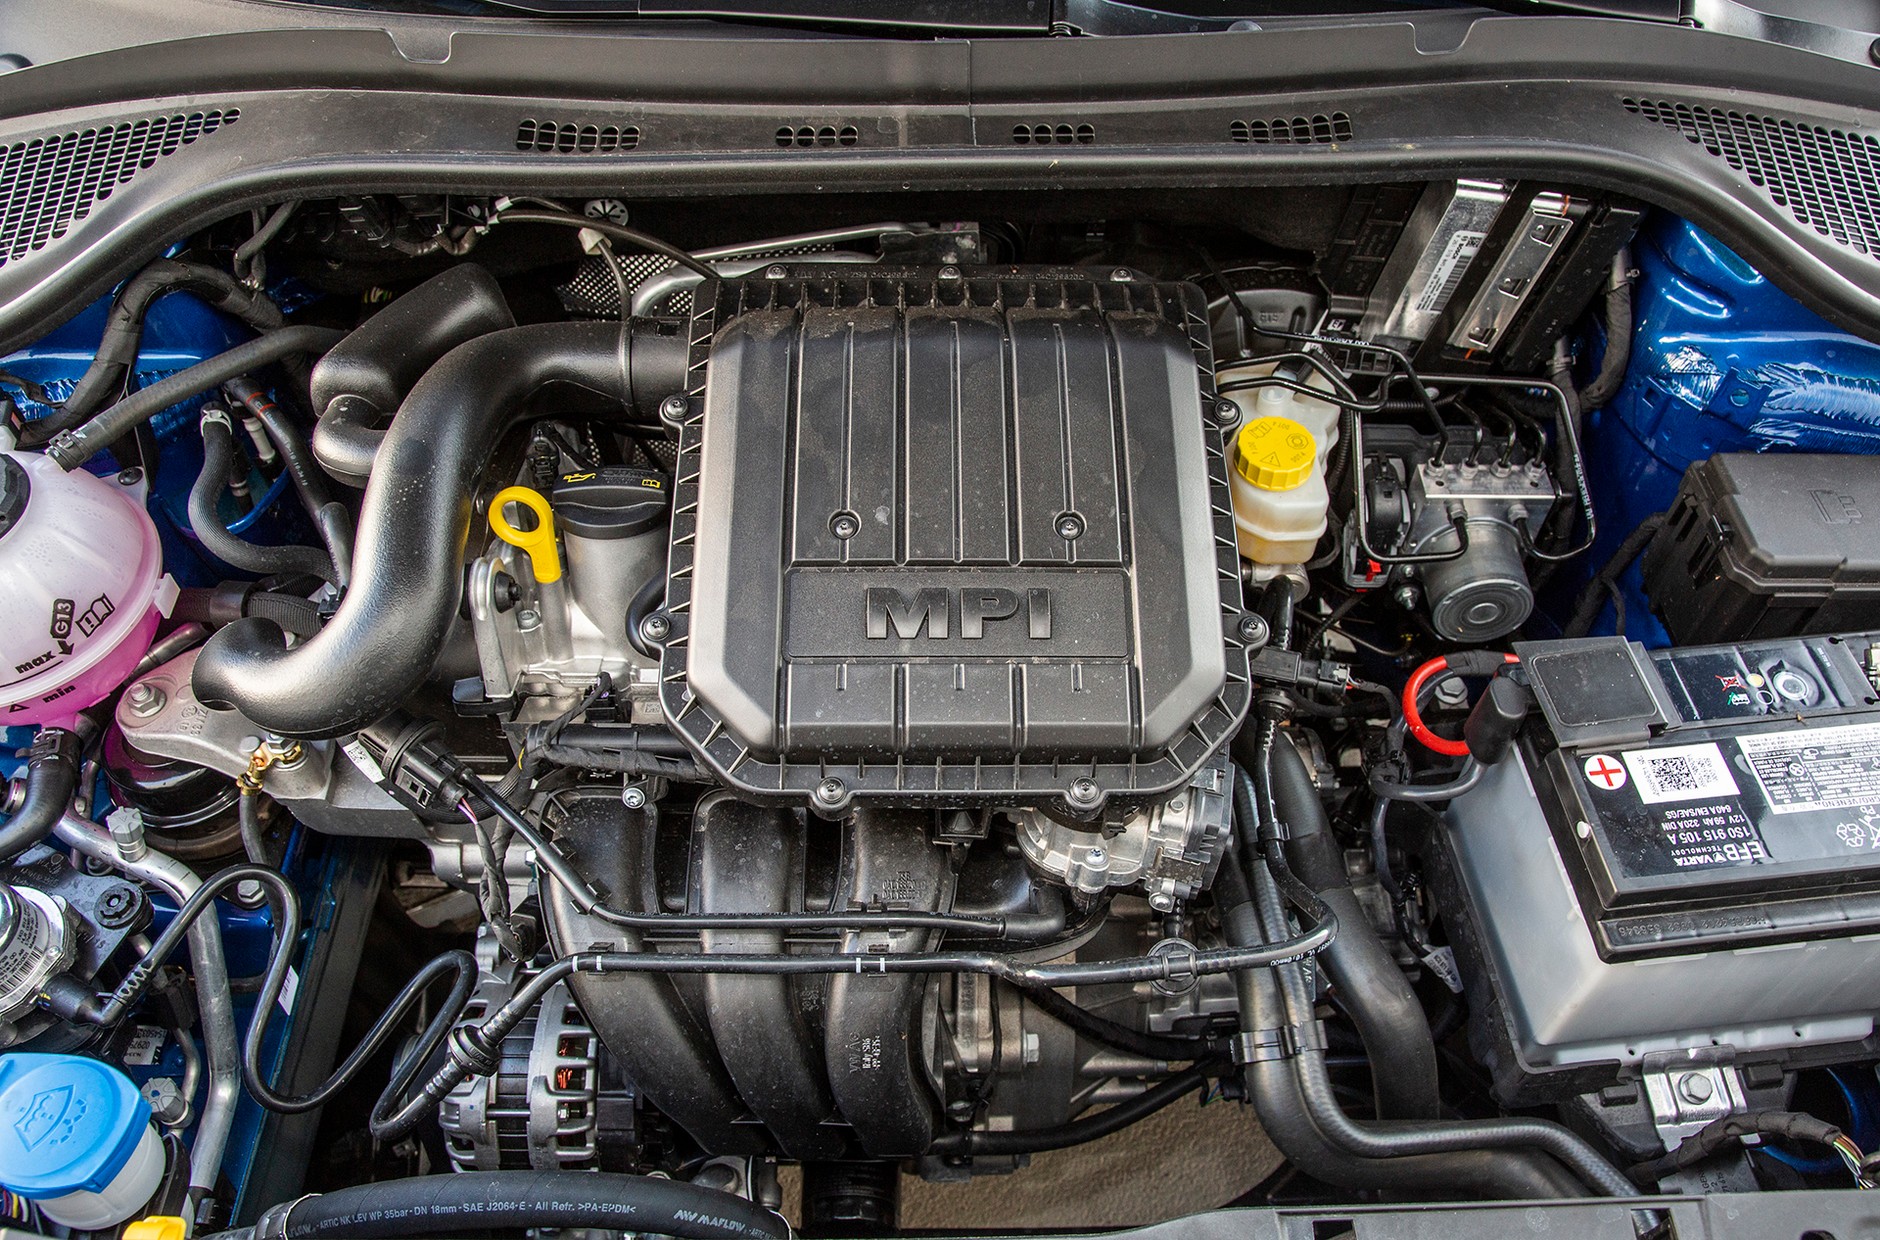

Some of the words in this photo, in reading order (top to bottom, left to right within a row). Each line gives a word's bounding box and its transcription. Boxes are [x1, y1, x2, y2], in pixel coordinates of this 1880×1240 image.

[55, 602, 72, 634] G13
[865, 587, 1053, 640] MPI
[14, 651, 57, 674] max
[42, 685, 76, 703] min
[1664, 807, 1709, 819] EN/SAE/GS
[1709, 804, 1732, 814] 640A
[1860, 805, 1876, 817] Pb
[1677, 819, 1700, 830] 320A
[1702, 816, 1726, 826] 59Ah
[1729, 814, 1746, 824] 12V
[1661, 822, 1677, 831] DIN
[1727, 826, 1751, 839] 1S0
[1667, 833, 1678, 845] A
[1679, 831, 1702, 844] 105
[1703, 828, 1727, 841] 915
[1671, 845, 1722, 856] TECHNOLOGY
[1723, 840, 1765, 861] EFB
[1673, 855, 1714, 867] VARTA
[318, 1217, 340, 1230] ARTIC
[339, 1213, 352, 1225] NK
[352, 1212, 368, 1223] LEV
[368, 1210, 383, 1221] WP
[384, 1208, 408, 1219] 35bar
[414, 1205, 428, 1216] DN
[430, 1205, 457, 1215] 18mm
[463, 1202, 485, 1213] SAE
[486, 1201, 526, 1212] J2064-E
[534, 1202, 549, 1210] All
[551, 1202, 575, 1212] Refr.
[697, 1214, 747, 1233] MAFLOW
